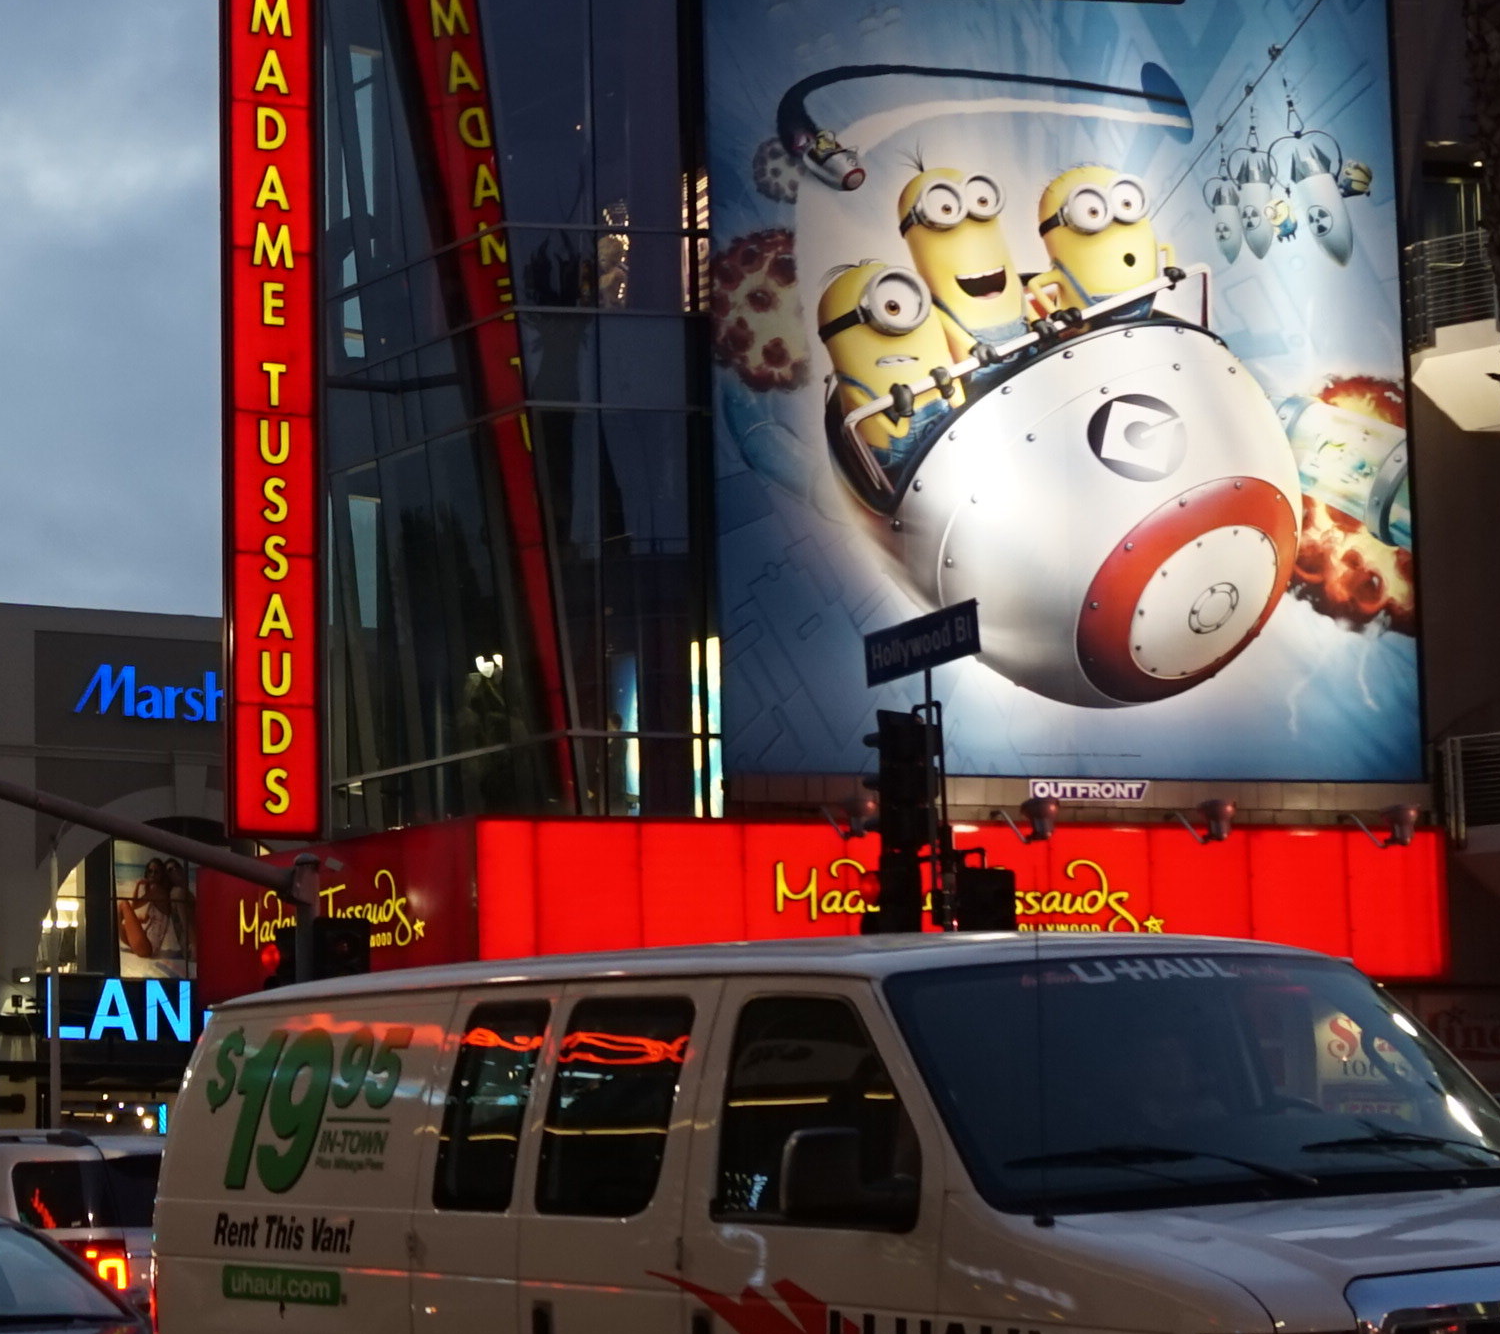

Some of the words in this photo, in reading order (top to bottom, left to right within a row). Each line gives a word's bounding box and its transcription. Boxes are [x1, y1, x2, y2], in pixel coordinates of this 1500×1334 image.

[258, 361, 294, 815] TUSSAUDS
[871, 619, 952, 671] Hollywood
[955, 613, 973, 644] Bl
[1034, 781, 1143, 799] OUTFRONT
[1068, 956, 1240, 985] U-HAUL
[47, 974, 212, 1042] LAN
[318, 1129, 389, 1155] IN-TOWN
[214, 1212, 258, 1248] Rent
[266, 1214, 303, 1251] This
[311, 1217, 354, 1254] Van!
[231, 1270, 331, 1299] uhaul.com
